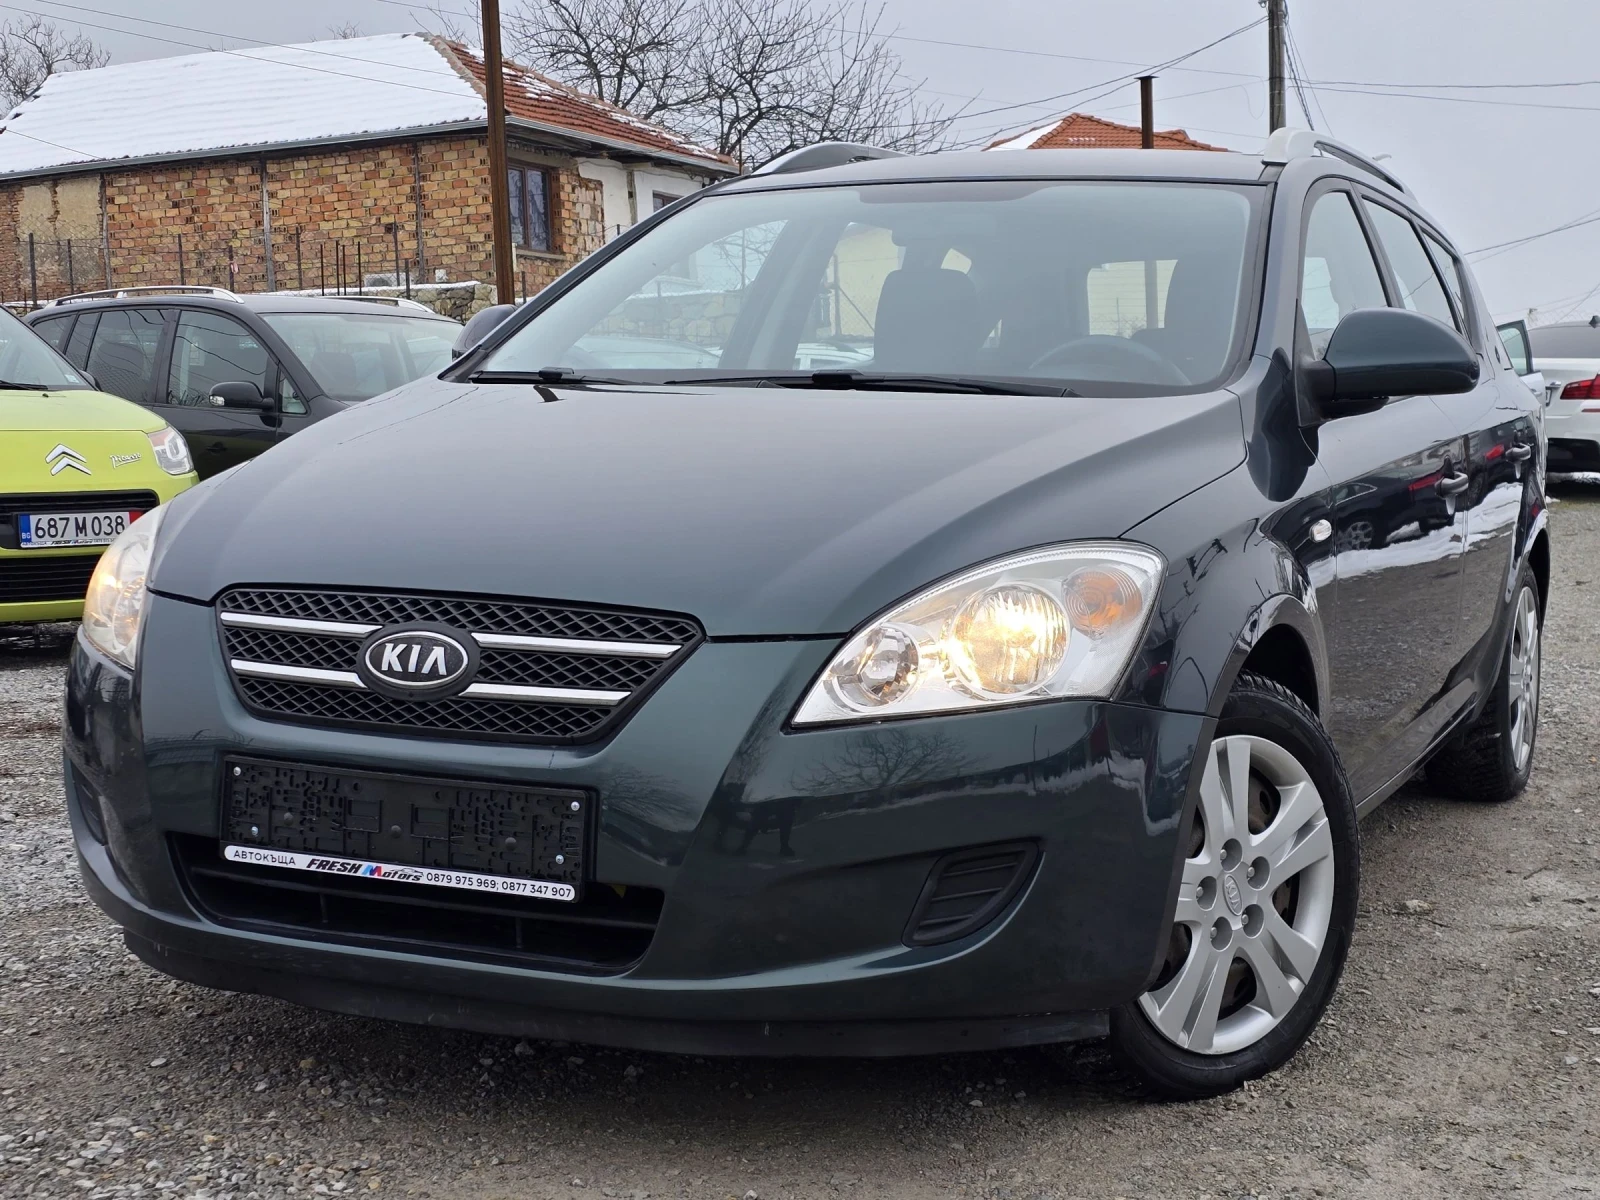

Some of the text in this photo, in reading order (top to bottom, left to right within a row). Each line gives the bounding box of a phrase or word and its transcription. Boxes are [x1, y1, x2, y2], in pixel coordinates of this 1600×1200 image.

[381, 643, 447, 676] KIA
[233, 850, 572, 898] АВТОКЪЩА FRESH Motors 0879 975 969; 0877 347 907
